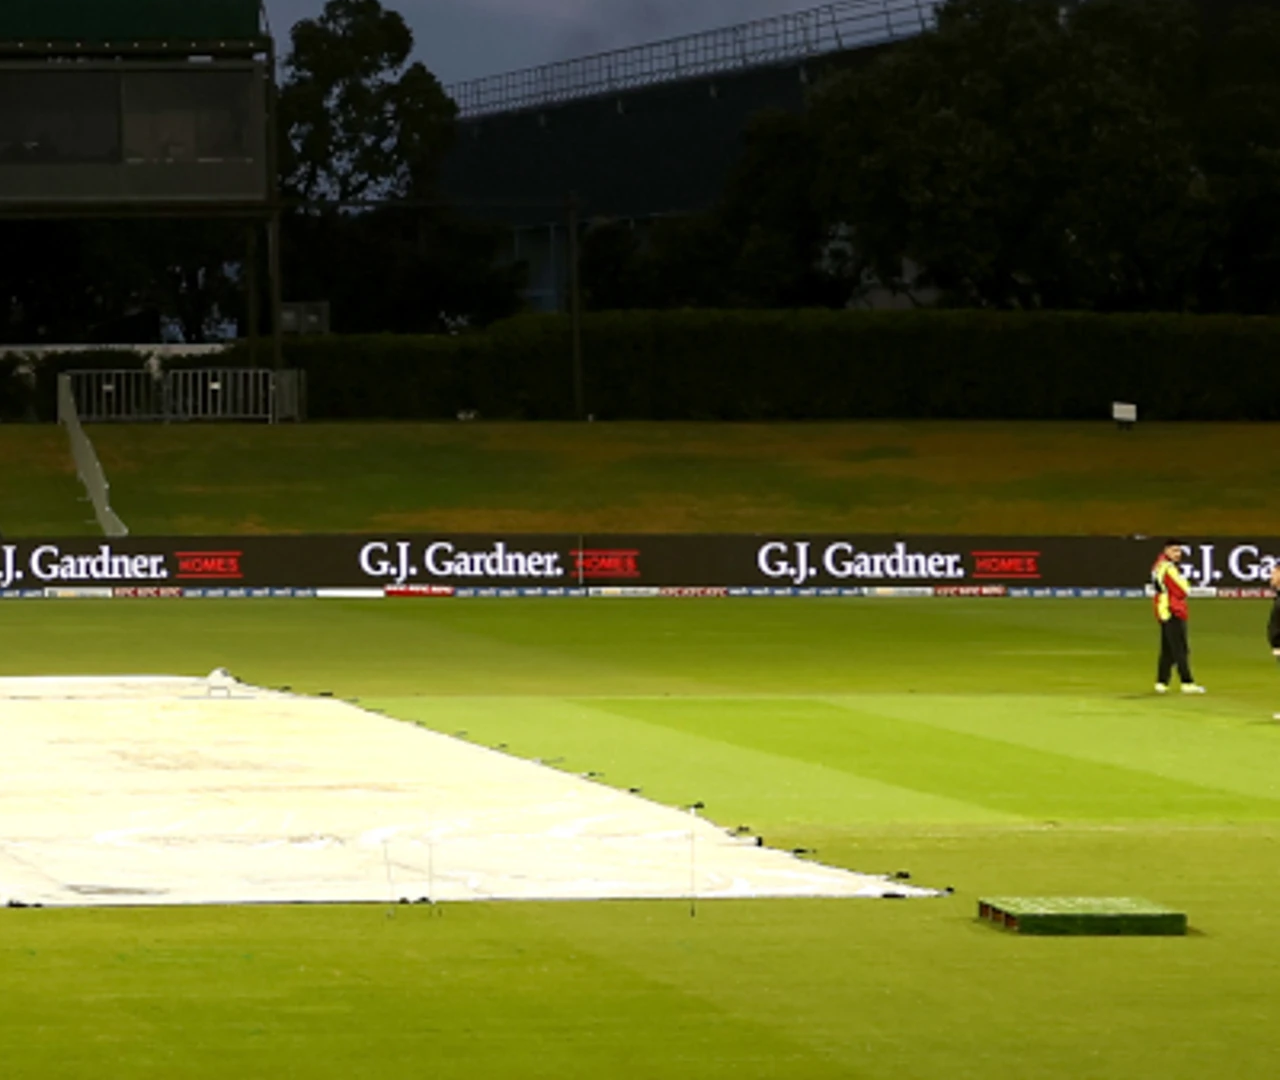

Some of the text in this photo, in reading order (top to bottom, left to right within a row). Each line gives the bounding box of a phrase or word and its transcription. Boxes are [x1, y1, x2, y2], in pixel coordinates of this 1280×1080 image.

[30, 545, 167, 581] Gardner.
[179, 557, 239, 572] HOMES
[358, 542, 417, 584] G.J.
[424, 542, 563, 577] Gardner.
[757, 542, 1036, 584] G.J. Gardner. HOMES
